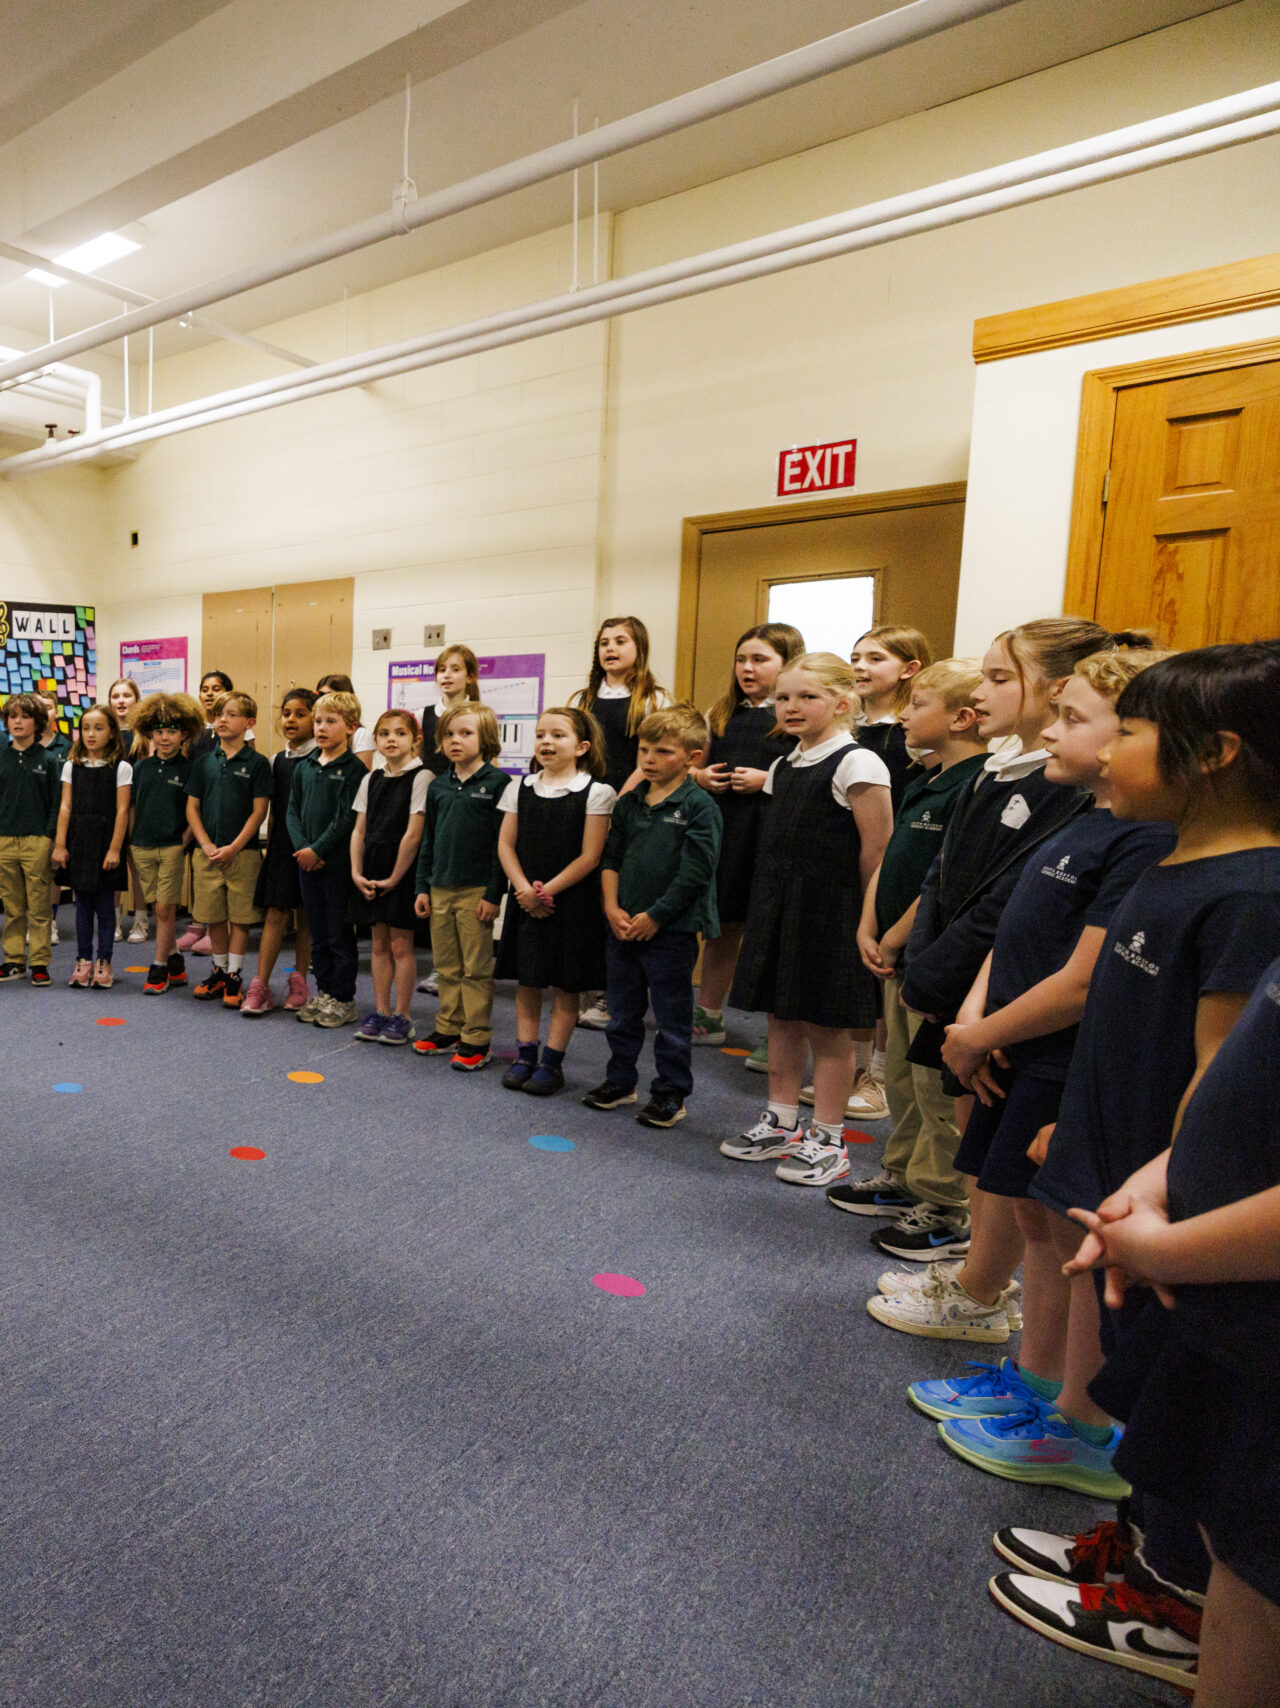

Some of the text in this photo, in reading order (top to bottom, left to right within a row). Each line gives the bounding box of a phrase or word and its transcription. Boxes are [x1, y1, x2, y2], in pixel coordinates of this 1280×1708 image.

[783, 444, 853, 492] EXIT
[15, 616, 70, 634] WALL
[392, 664, 422, 677] Musical
